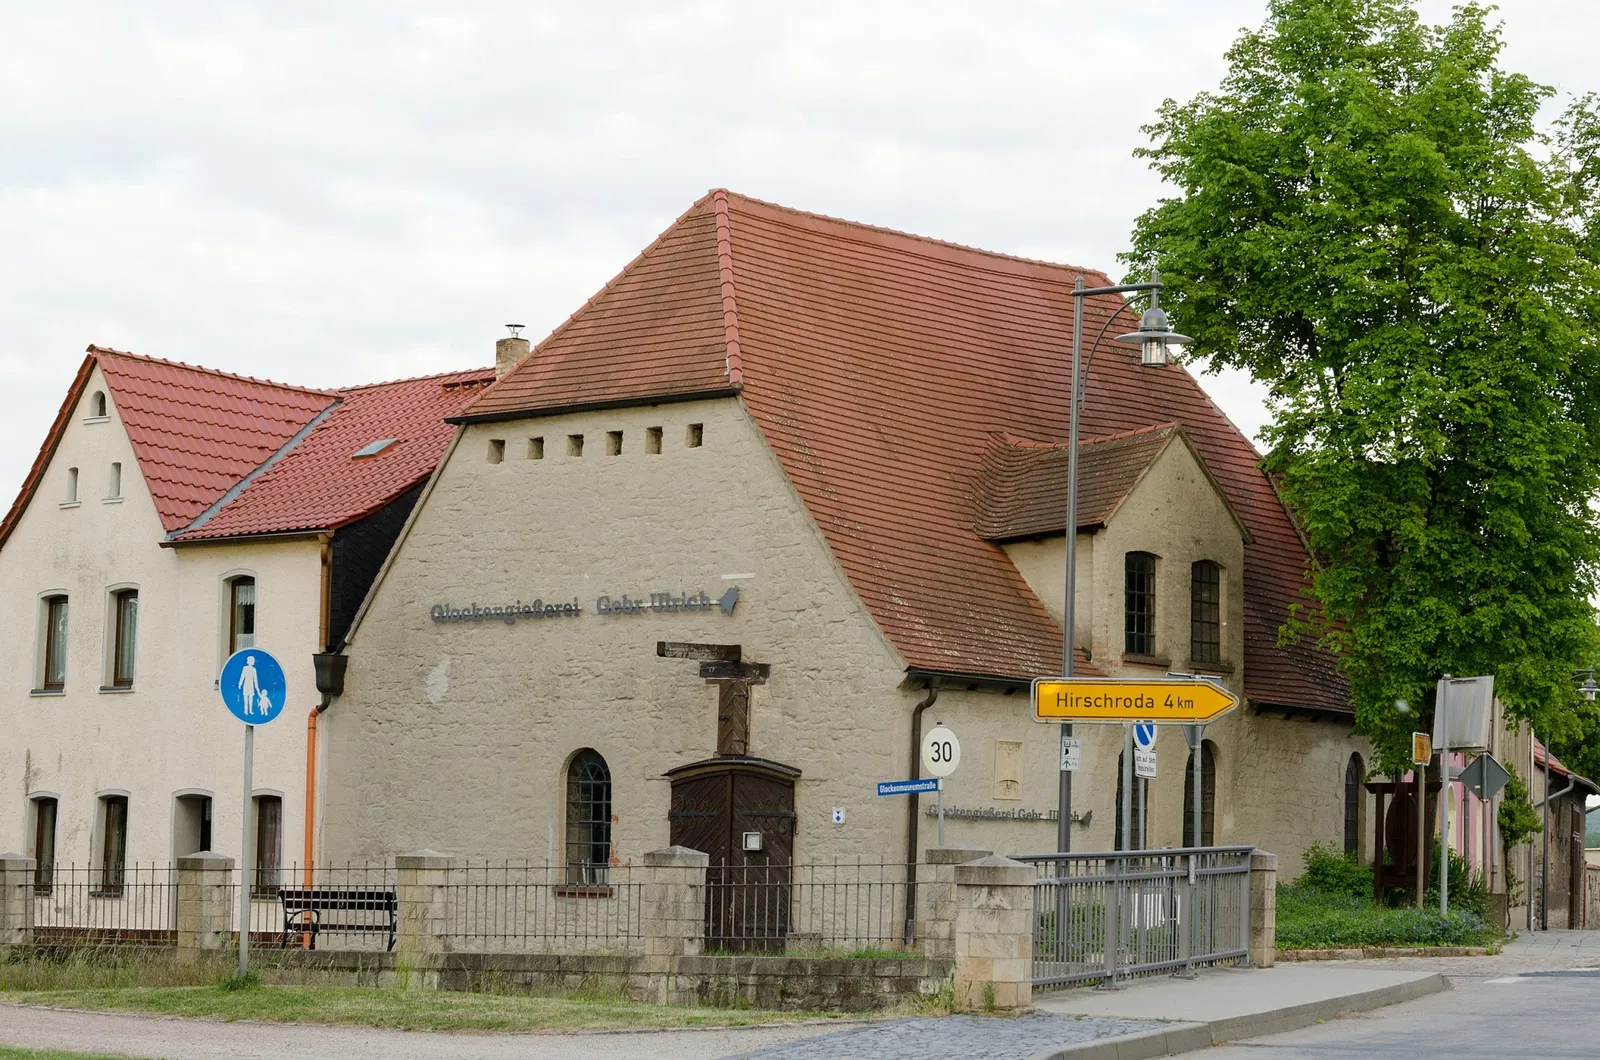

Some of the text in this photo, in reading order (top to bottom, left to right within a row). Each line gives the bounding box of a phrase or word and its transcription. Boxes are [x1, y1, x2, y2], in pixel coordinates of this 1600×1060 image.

[430, 597, 580, 625] Glockengießerei
[650, 590, 712, 613] Ulrich
[1056, 692, 1194, 709] Hirschroda 4 km
[931, 740, 952, 763] 30
[879, 781, 936, 794] Glockenmuseumstraße
[928, 804, 1015, 822] Gockengießerei
